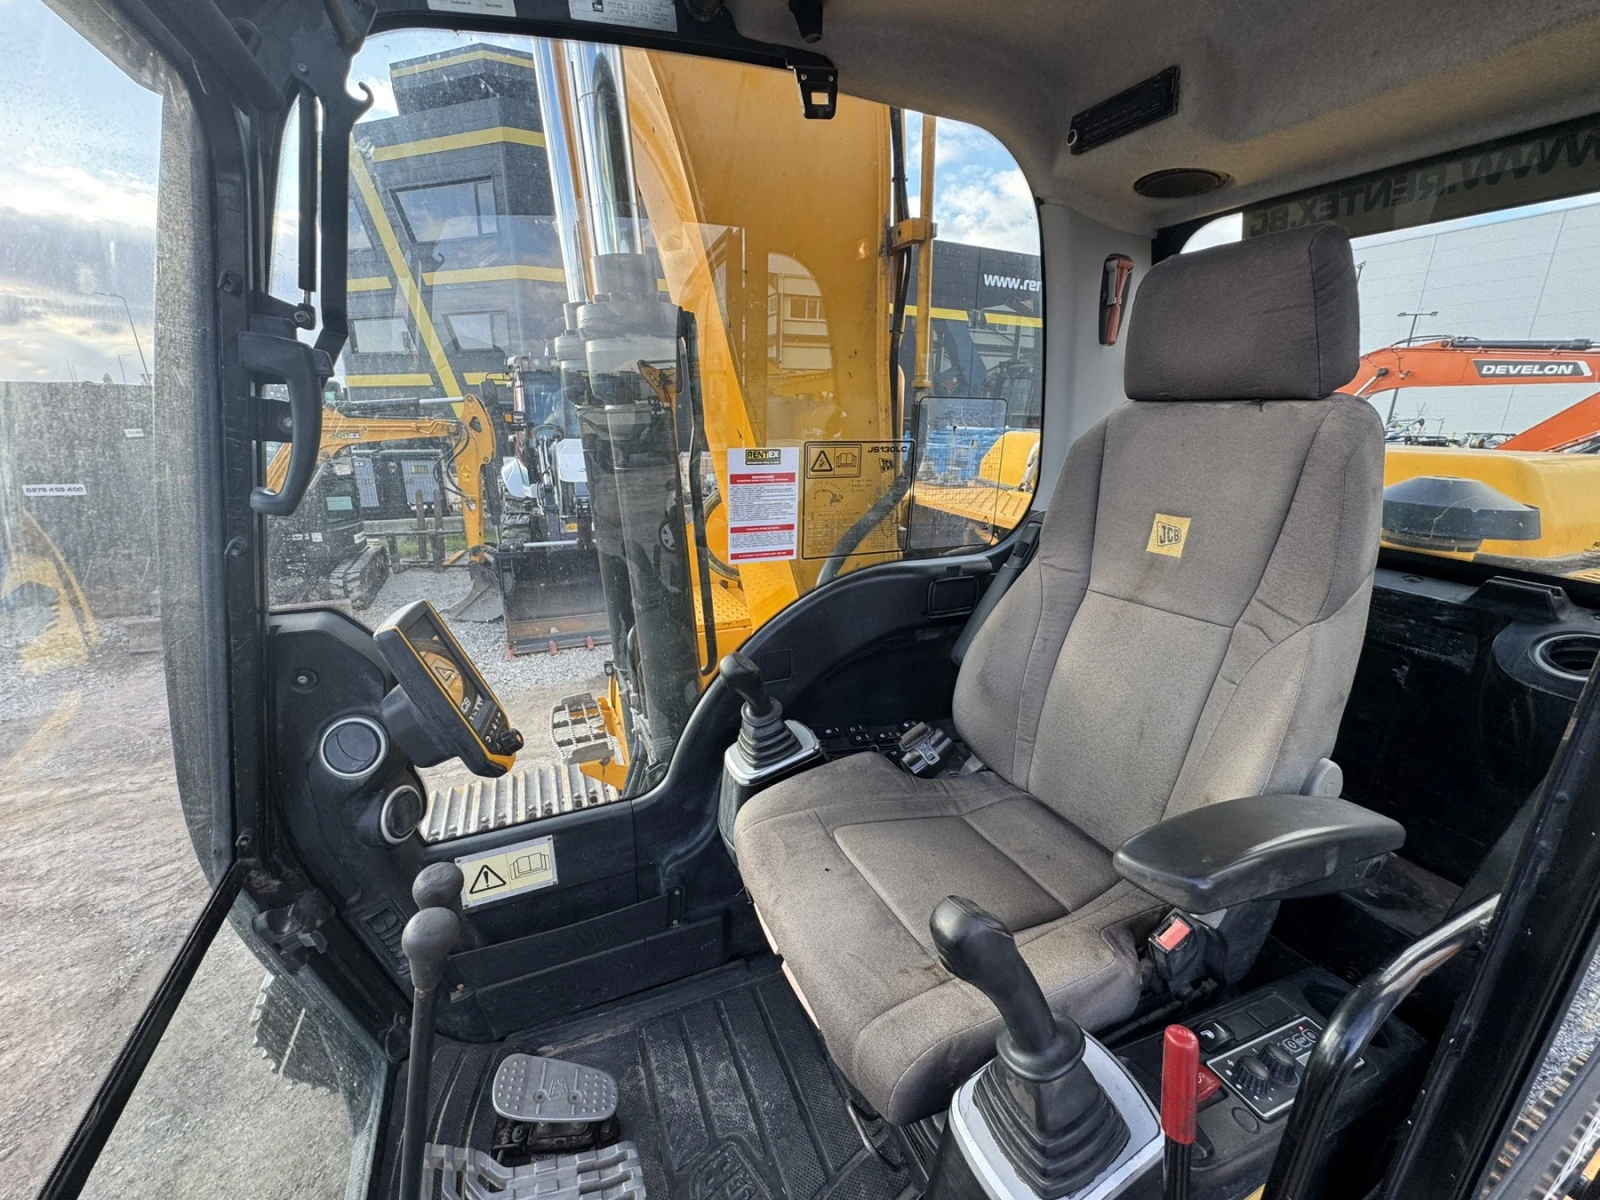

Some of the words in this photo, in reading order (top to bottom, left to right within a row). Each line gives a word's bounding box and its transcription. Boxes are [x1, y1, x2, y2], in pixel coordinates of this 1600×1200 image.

[1481, 363, 1574, 375] DEVELON
[747, 450, 779, 459] RENTEX
[868, 445, 907, 454] JS130LC
[1159, 525, 1180, 544] JCB
